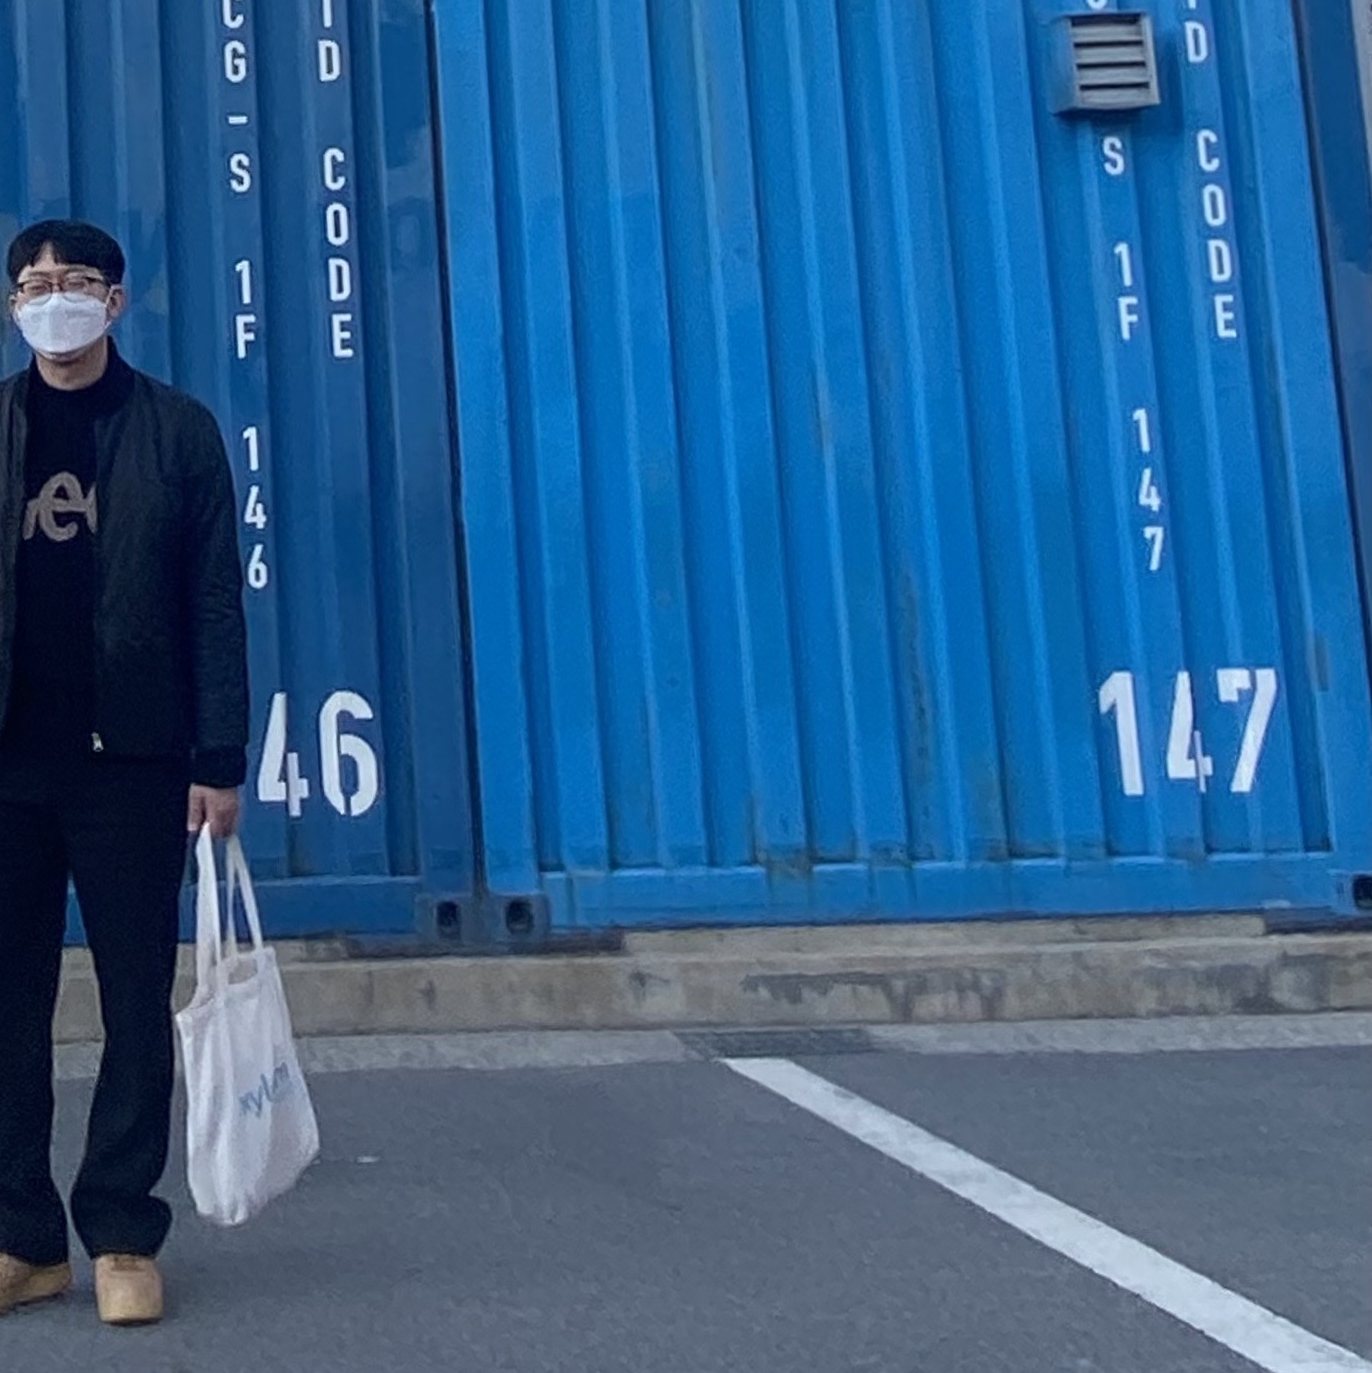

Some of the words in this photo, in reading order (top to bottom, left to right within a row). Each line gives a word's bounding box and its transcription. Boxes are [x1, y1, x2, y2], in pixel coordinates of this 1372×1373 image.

[235, 261, 257, 358] 1F
[323, 148, 354, 358] CODE
[1196, 129, 1237, 338] CODE
[1114, 243, 1139, 340] 1F
[1133, 408, 1162, 571] 147
[242, 427, 269, 589] 146
[257, 691, 379, 818] 46
[1098, 669, 1278, 796] 147
